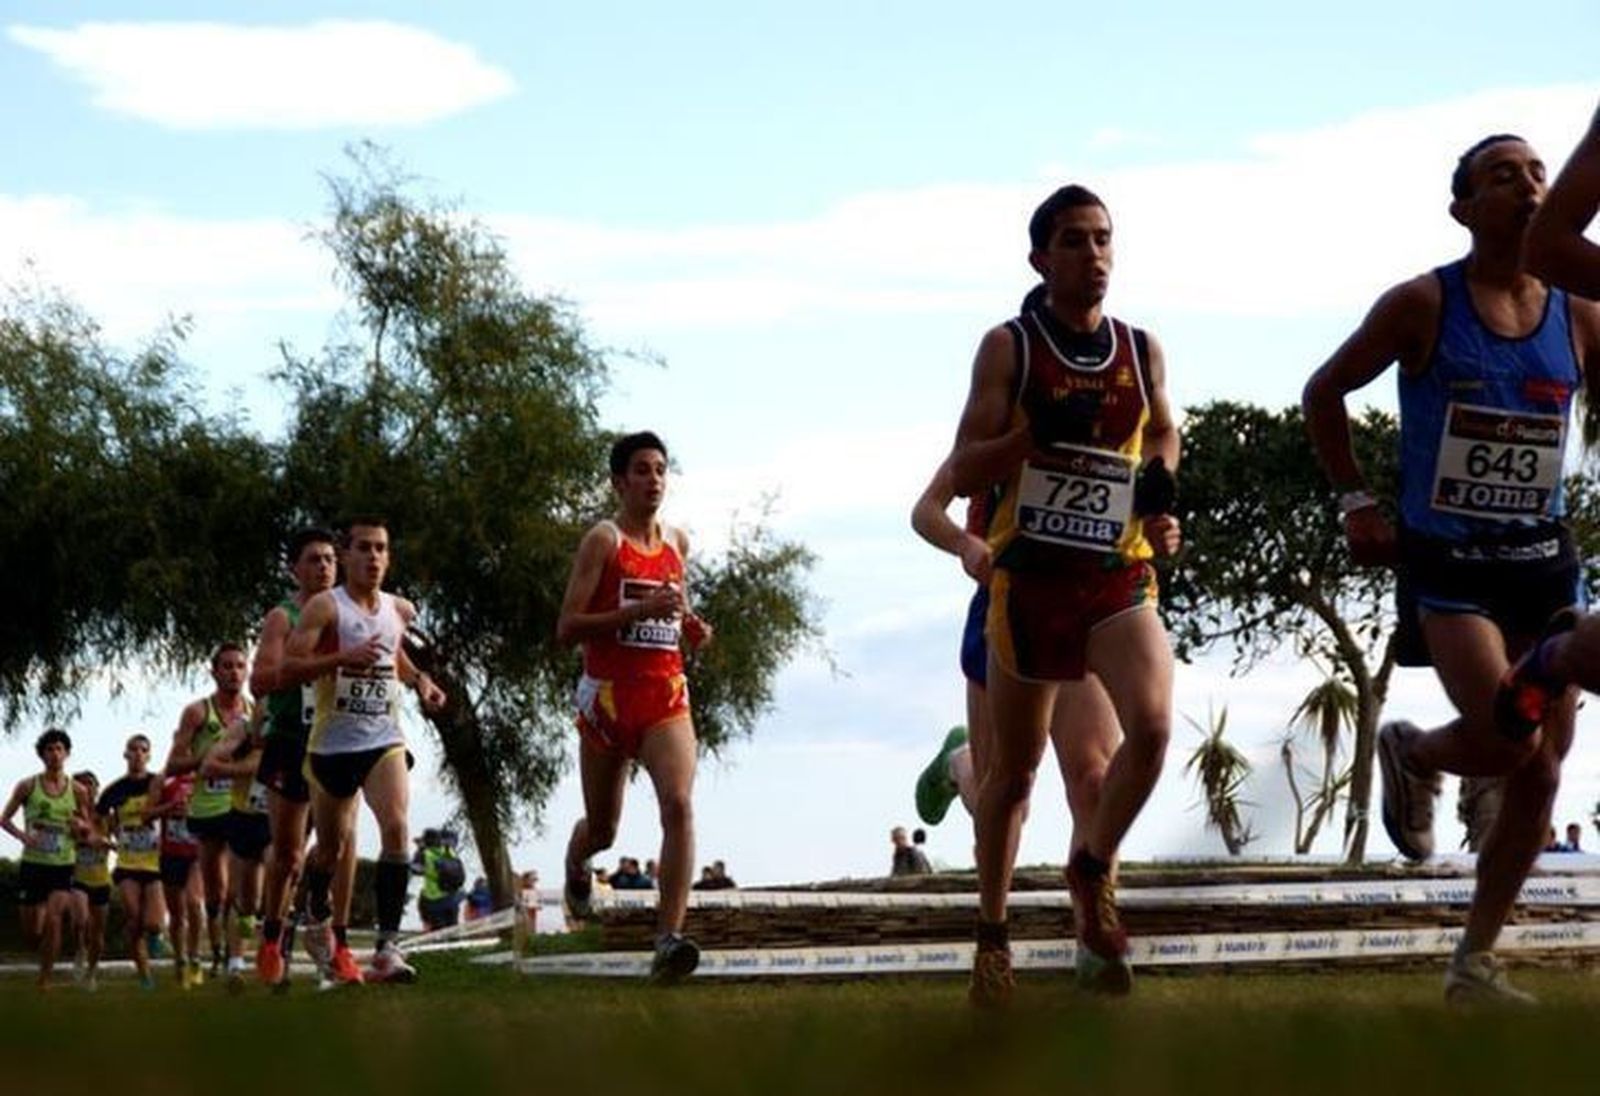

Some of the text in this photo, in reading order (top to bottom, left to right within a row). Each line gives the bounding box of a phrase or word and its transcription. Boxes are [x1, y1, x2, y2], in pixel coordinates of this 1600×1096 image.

[1466, 443, 1539, 483] 643
[1045, 475, 1111, 515] 723
[350, 681, 388, 699] 676
